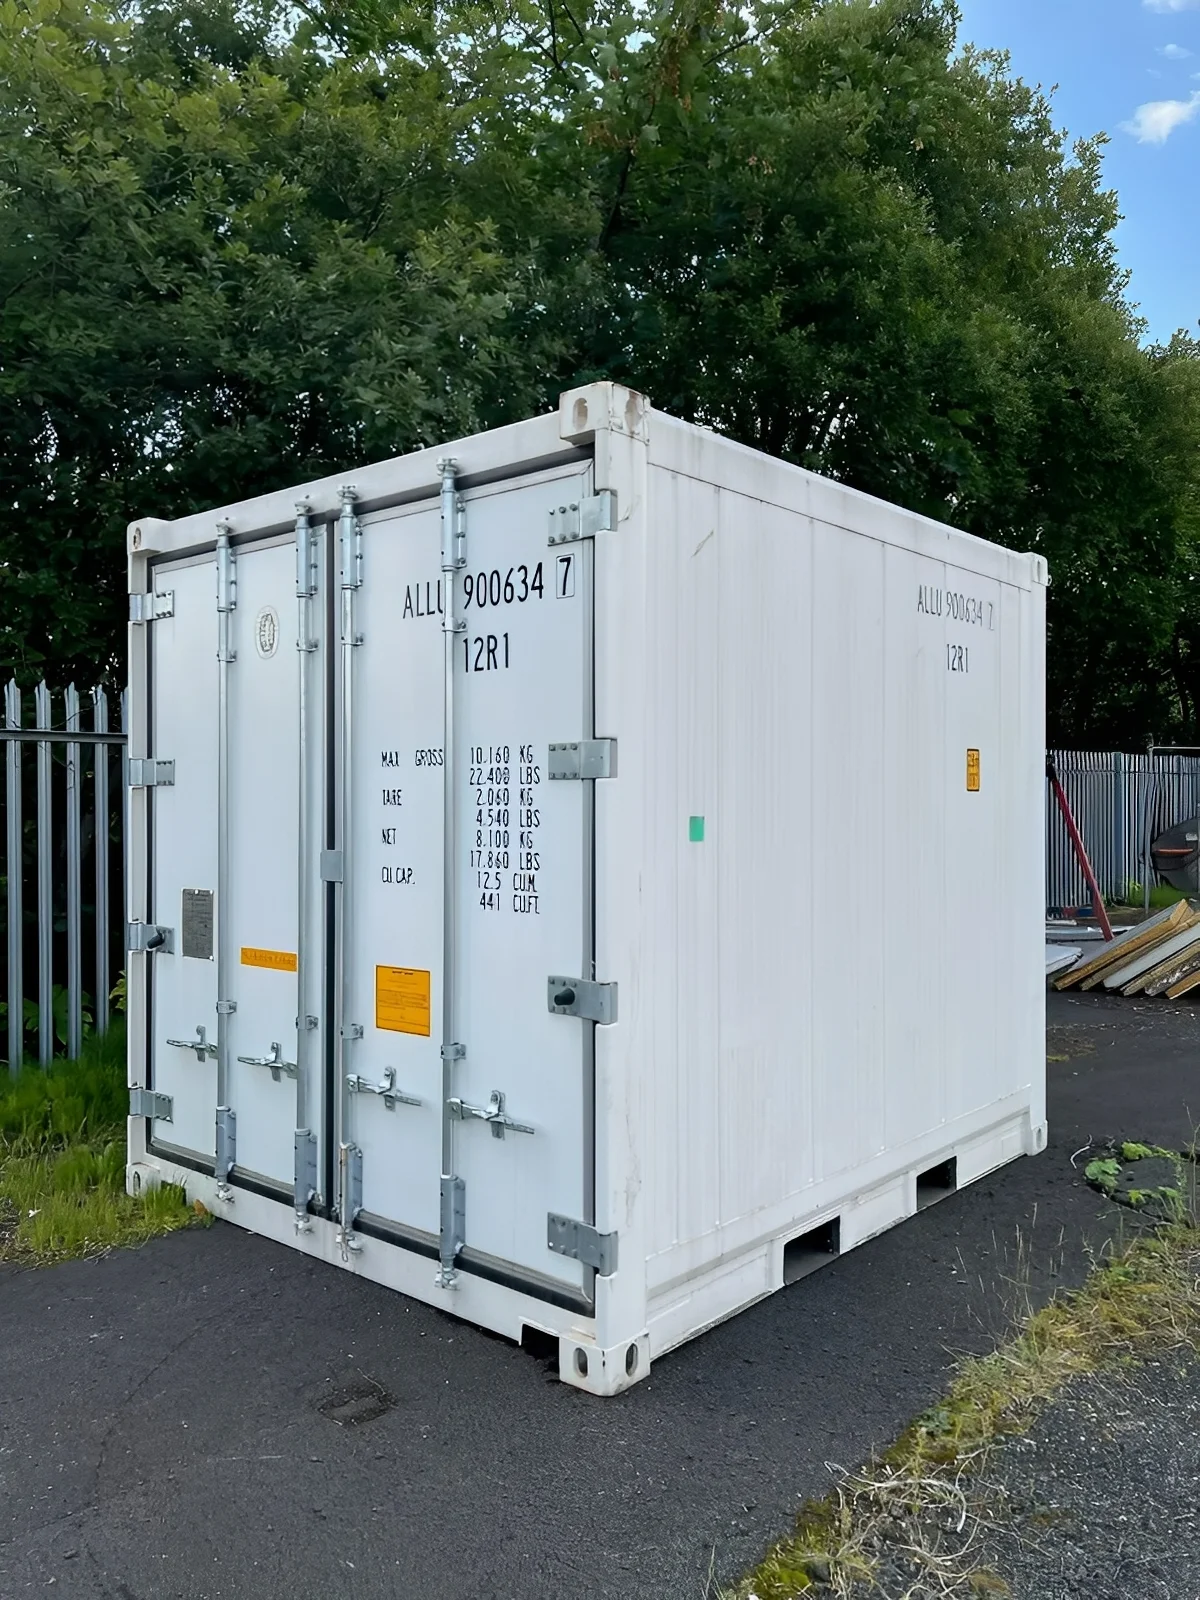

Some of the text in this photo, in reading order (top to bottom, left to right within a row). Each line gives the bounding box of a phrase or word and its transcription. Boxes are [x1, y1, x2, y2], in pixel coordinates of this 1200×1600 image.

[463, 562, 544, 609] 900634
[558, 556, 572, 596] 7
[917, 584, 942, 617] ALLU
[463, 633, 509, 673] 12R1
[946, 643, 969, 673] 12R1
[415, 748, 444, 767] GROSS
[519, 744, 533, 764] KG
[519, 765, 541, 785] LBS
[519, 787, 533, 807] KG
[519, 808, 541, 828] LBS
[381, 828, 397, 845] NET
[519, 830, 533, 849] KG
[519, 852, 541, 871] LBS
